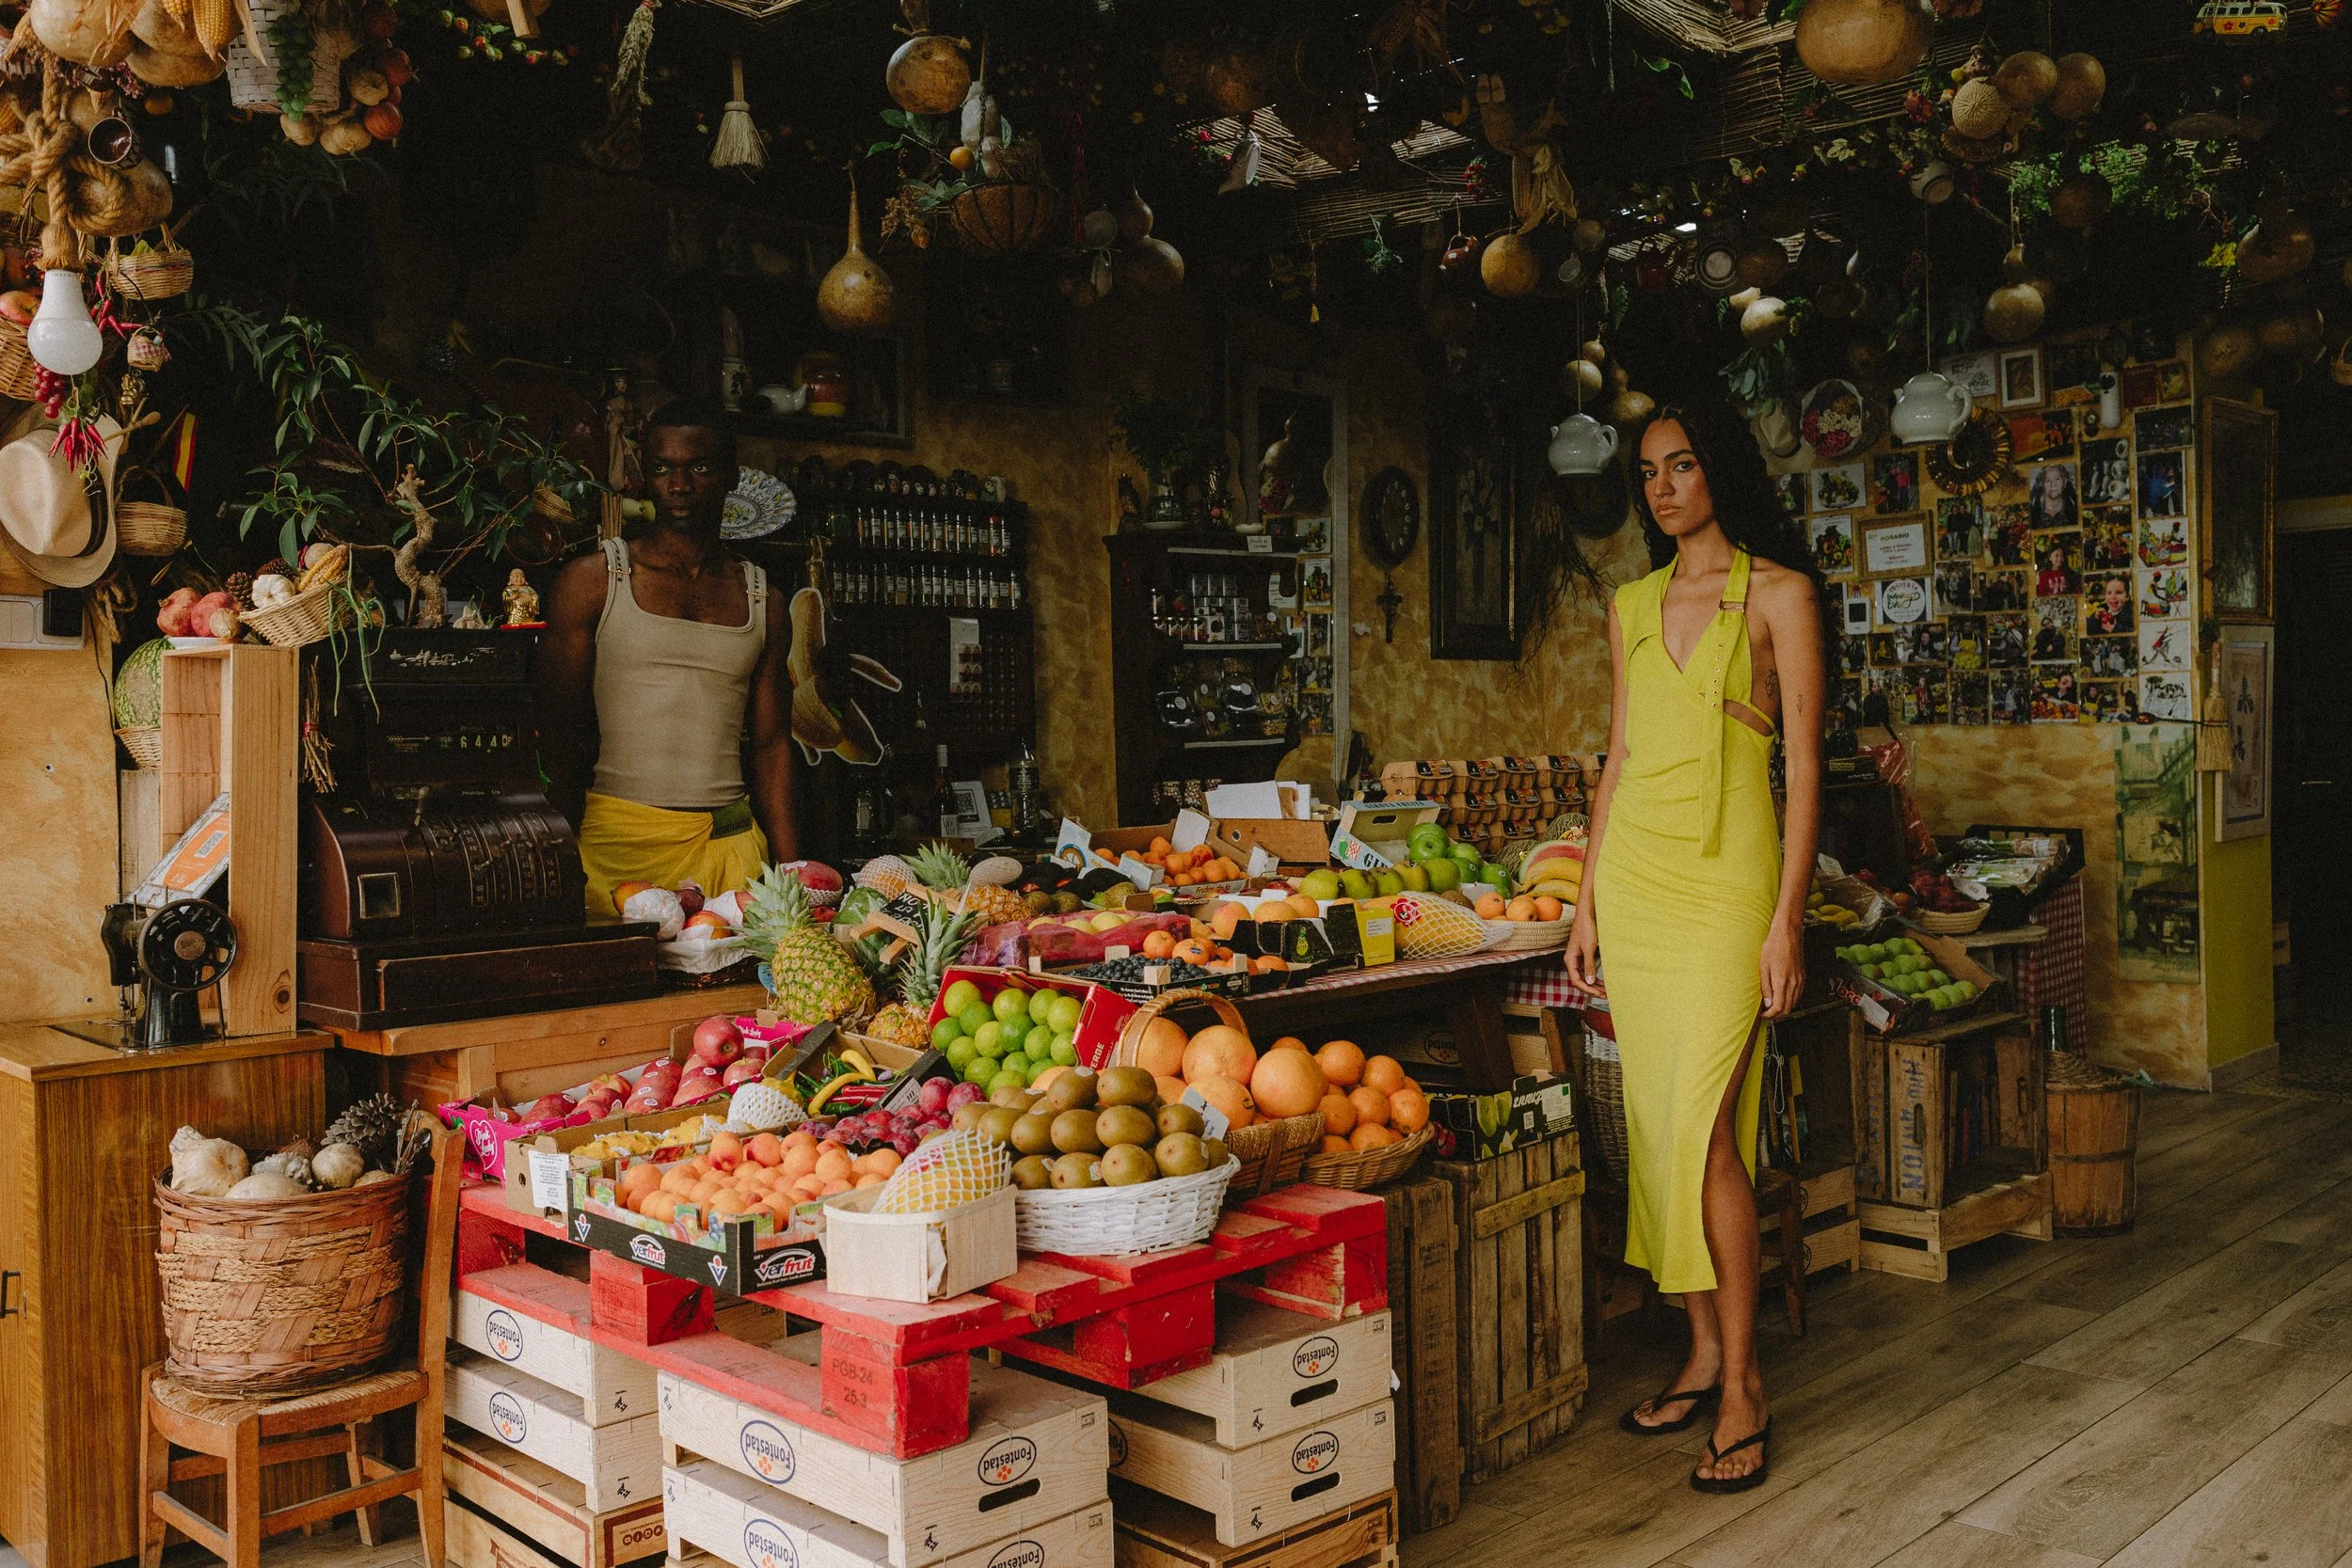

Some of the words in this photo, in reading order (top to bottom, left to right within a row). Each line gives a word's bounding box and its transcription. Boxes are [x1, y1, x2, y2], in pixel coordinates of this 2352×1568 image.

[1880, 532, 1910, 542] HORARIO
[898, 893, 919, 905] NO
[475, 1124, 490, 1145] Pink
[479, 1140, 495, 1157] Lady
[489, 1321, 520, 1348] Fontestad
[1297, 1345, 1335, 1367] Fontestad
[832, 1359, 873, 1386] PGB-24
[844, 1388, 867, 1408] 25-3
[492, 1403, 523, 1431] Fontestad
[745, 1433, 791, 1470] Fontestad
[983, 1446, 1032, 1475] Fontestad
[1296, 1440, 1335, 1464] Fontestad
